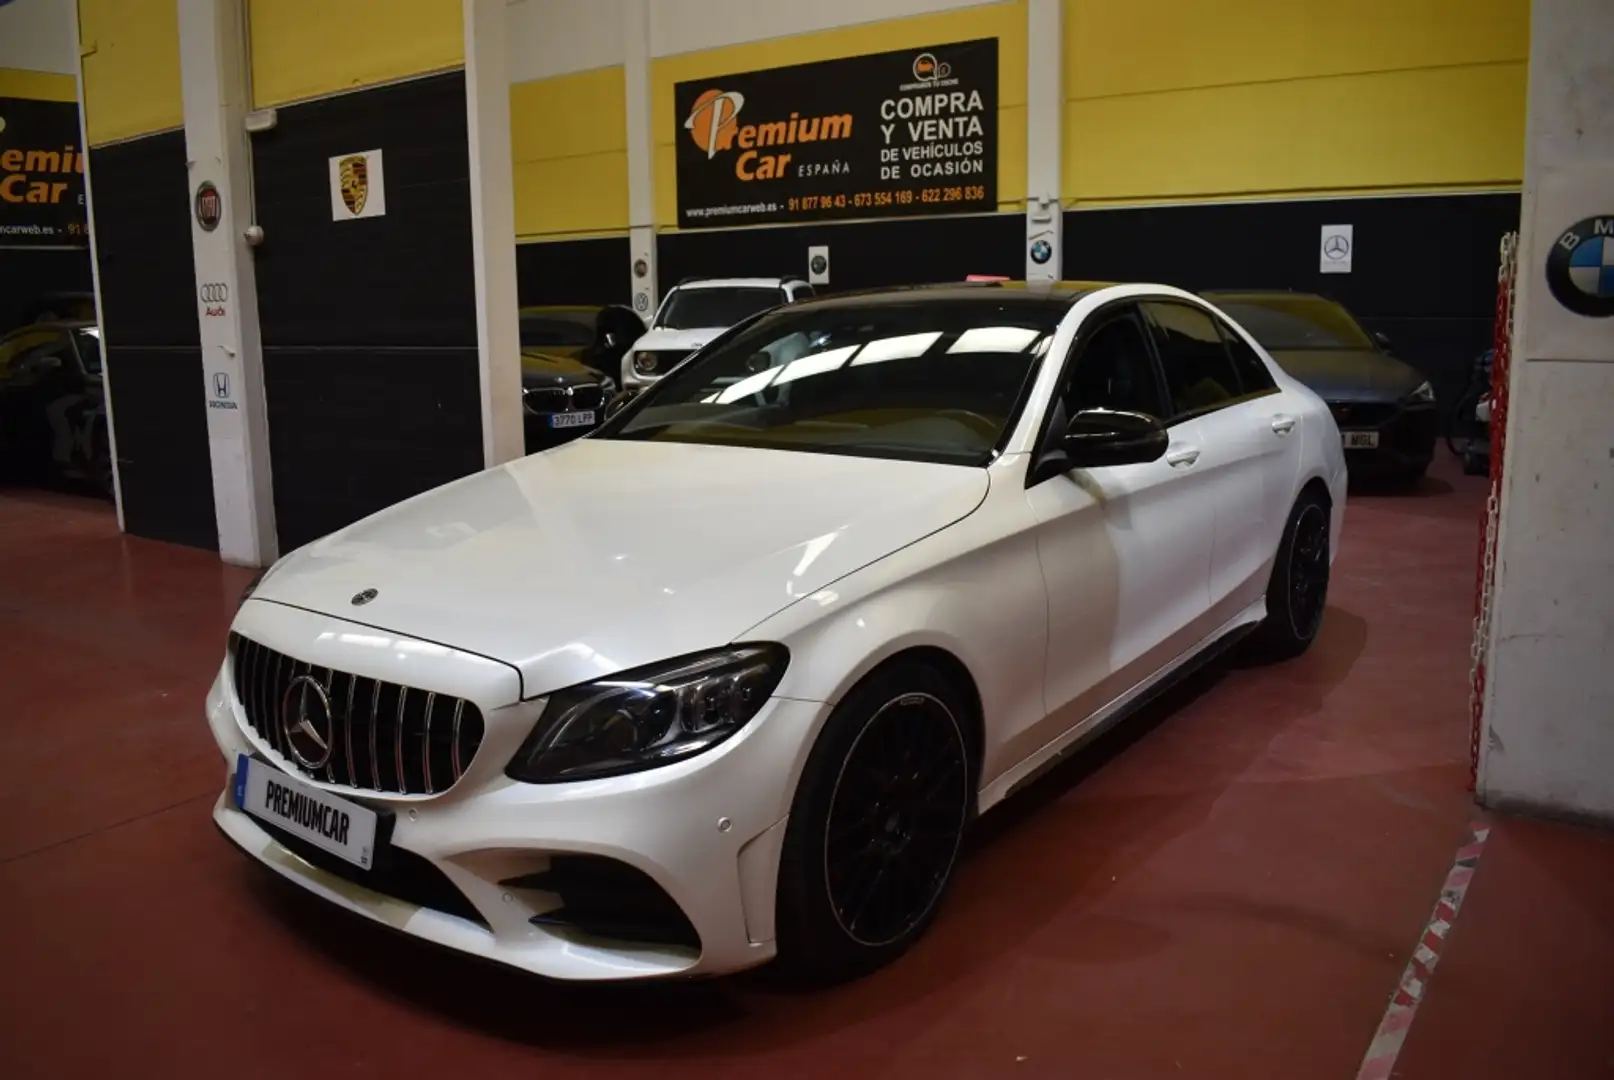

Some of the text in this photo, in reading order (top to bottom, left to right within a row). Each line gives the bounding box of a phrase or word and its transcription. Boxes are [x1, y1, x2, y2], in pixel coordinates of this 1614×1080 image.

[880, 90, 984, 121] COMPRA
[684, 89, 853, 160] Premium
[880, 115, 984, 145] Y VENTA
[735, 149, 792, 182] Car
[880, 140, 984, 163] DE VEHÍCULOS
[797, 159, 851, 178] ESPAÑA
[880, 156, 984, 180] DE OCASIÓN
[0, 174, 68, 204] Car
[686, 202, 777, 217] www.premiumcarweb.es
[787, 197, 800, 211] 91
[834, 194, 846, 208] 43
[854, 192, 872, 207] 673
[874, 191, 892, 206] 554
[922, 187, 940, 202] 622
[205, 306, 226, 317] Audi
[554, 414, 577, 426] 3770
[266, 780, 350, 845] PREMIUMCAR
